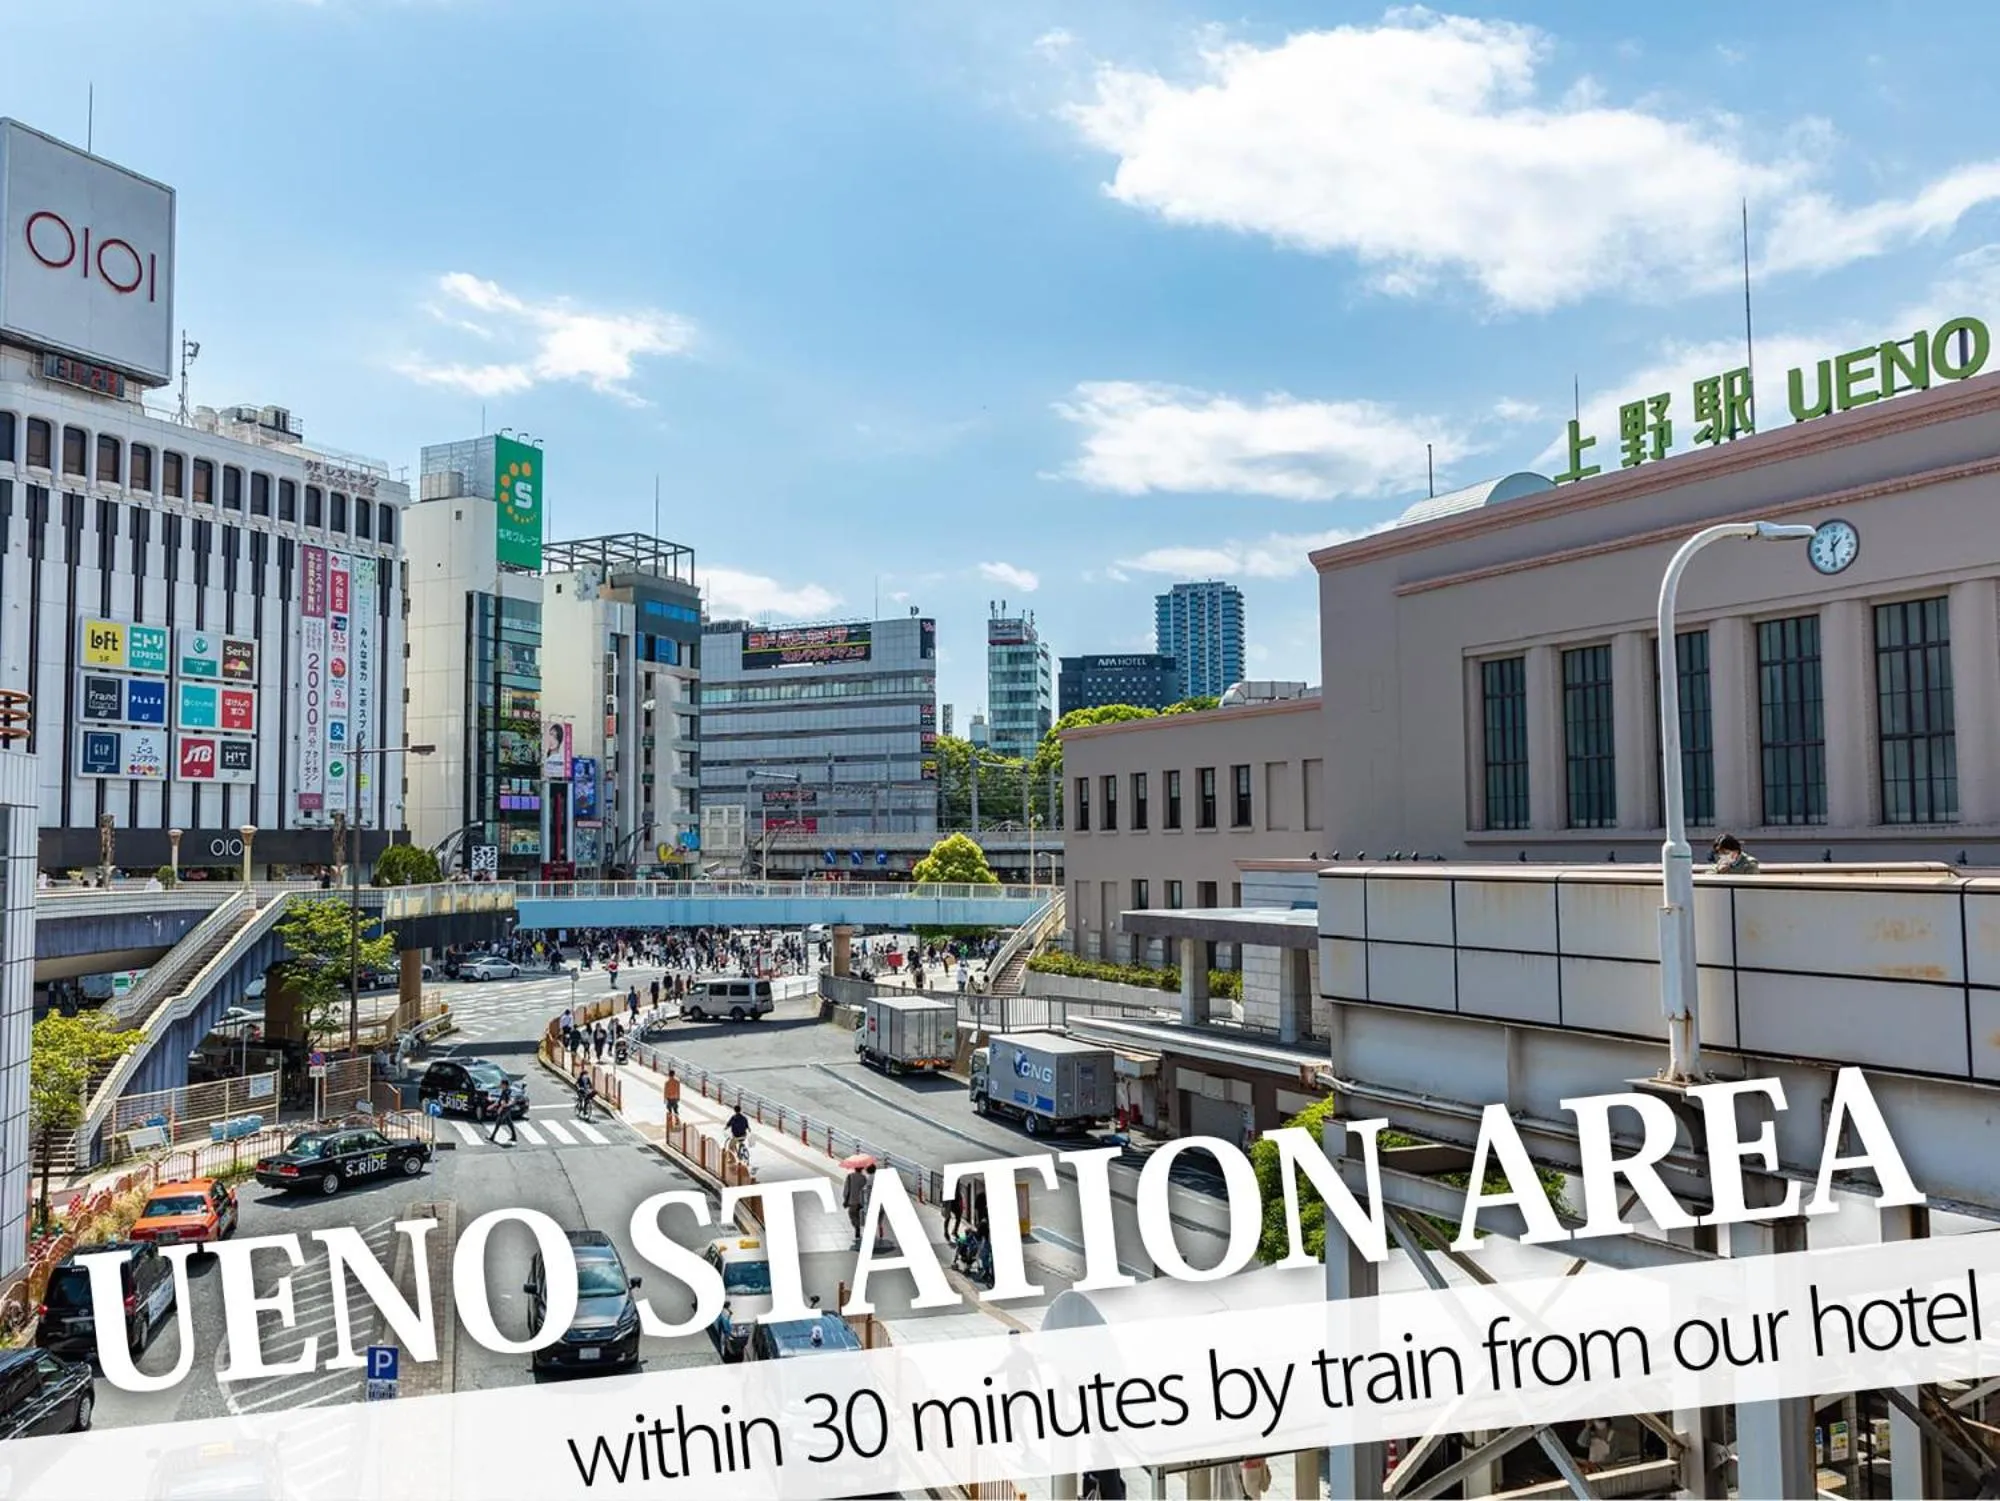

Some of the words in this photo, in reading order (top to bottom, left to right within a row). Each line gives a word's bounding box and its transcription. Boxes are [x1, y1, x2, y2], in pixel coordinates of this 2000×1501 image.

[1554, 367, 1754, 483] 上野駅
[1787, 317, 1990, 422] UENO
[131, 632, 164, 650] ニトリ
[225, 645, 252, 658] Seria
[1117, 657, 1147, 667] HOTEL
[1020, 1062, 1054, 1083] CNG
[345, 1158, 388, 1178] S.RIDE
[375, 1350, 393, 1377] P
